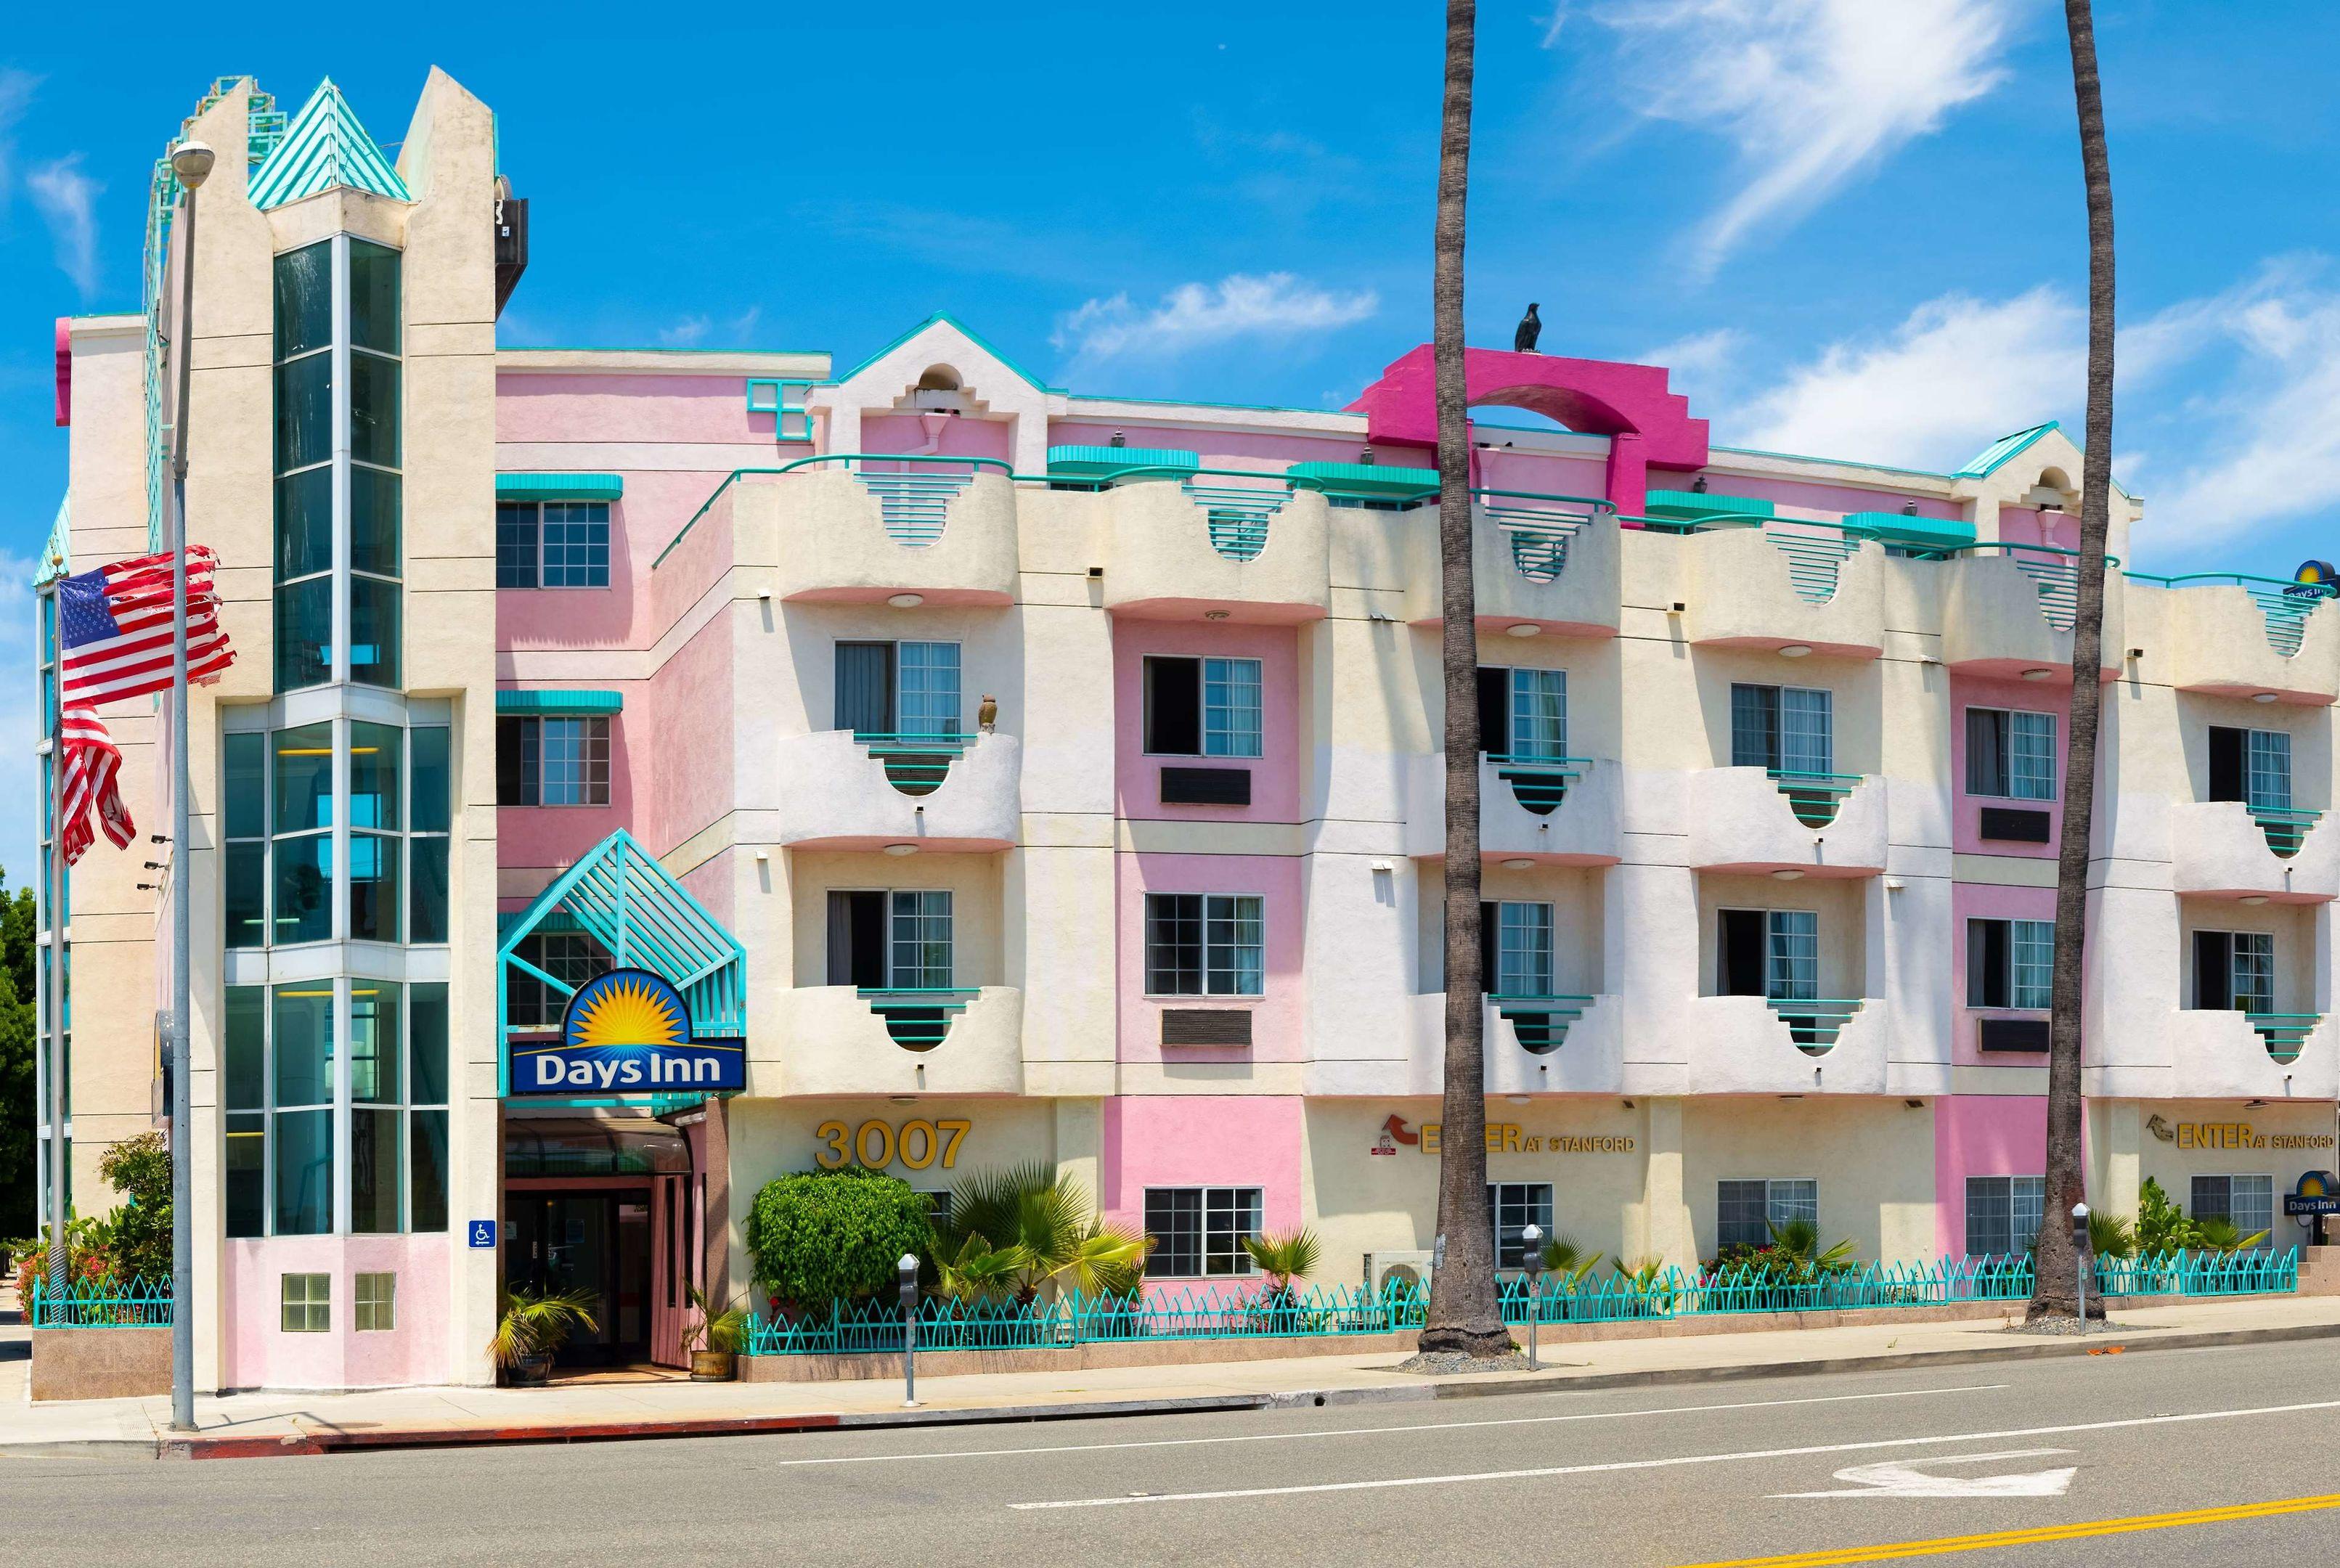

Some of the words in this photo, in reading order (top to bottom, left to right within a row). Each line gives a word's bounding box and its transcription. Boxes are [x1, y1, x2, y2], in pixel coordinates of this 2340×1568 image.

[537, 1055, 643, 1088] Days
[651, 1053, 720, 1082] Inn
[815, 1119, 971, 1170] 3007
[1420, 1123, 1522, 1153] EER
[1525, 1136, 1544, 1152] AT
[1549, 1135, 1636, 1153] STANFORD
[2177, 1123, 2254, 1149] ENTER
[2254, 1135, 2268, 1148] AT
[2272, 1135, 2334, 1149] STANFORD
[2289, 1201, 2317, 1212] Days
[2317, 1200, 2336, 1209] Inn
